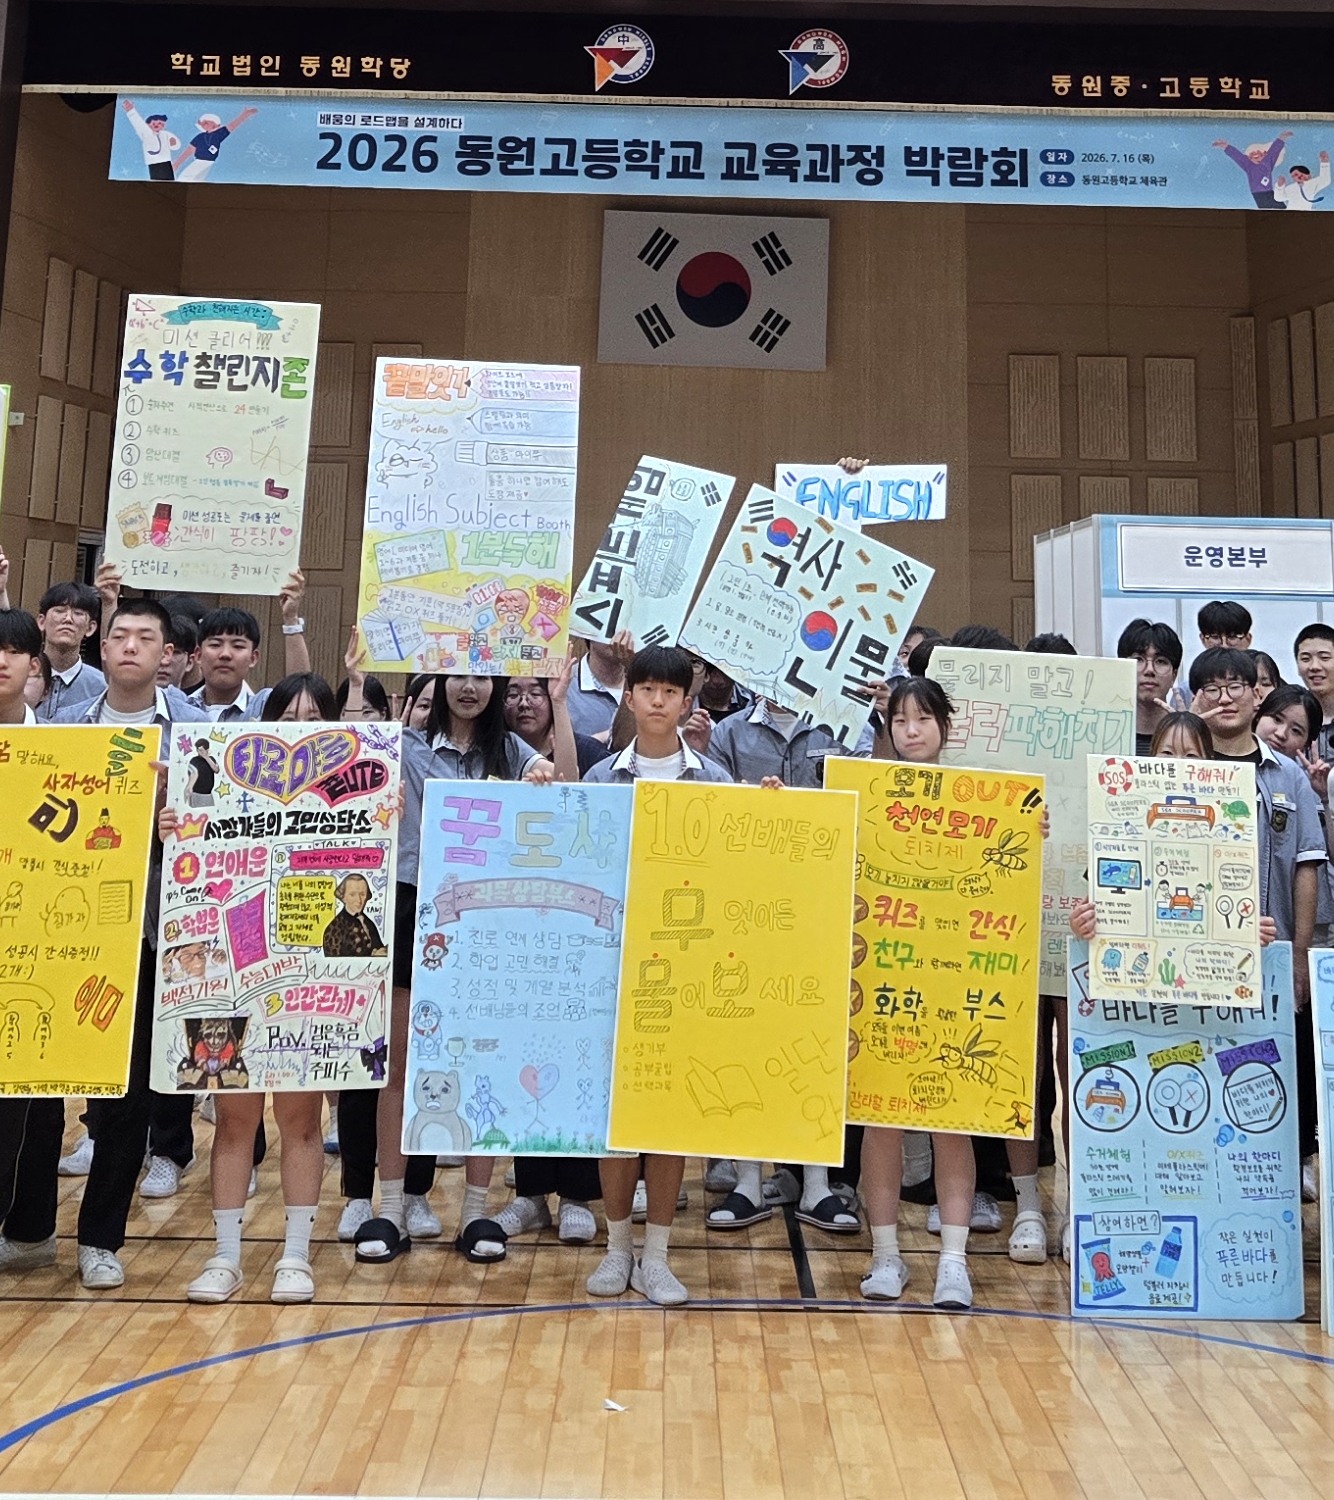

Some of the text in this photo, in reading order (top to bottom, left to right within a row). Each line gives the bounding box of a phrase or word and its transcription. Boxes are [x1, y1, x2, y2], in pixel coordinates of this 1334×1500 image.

[171, 53, 411, 80] 학교법인 동원학당
[319, 113, 463, 129] 배움의 로드맵을 설계하다
[316, 132, 705, 180] 2026 동원고등학교
[720, 141, 1030, 188] 교육과정 박람회
[1082, 175, 1167, 186] 동원고등학교 체육관
[163, 330, 199, 349] 미션
[124, 349, 189, 385] 수학
[383, 363, 470, 401] 끝말잇기
[367, 493, 570, 530] English Subject Booth
[796, 477, 932, 521] ENGLISH
[180, 527, 214, 542] 간식이
[462, 531, 560, 569] 1분독해
[1184, 545, 1268, 568] 운영본부
[132, 560, 178, 577] 도전하고,
[936, 660, 1011, 692] 물리지
[17, 749, 59, 770] 말해요,
[43, 772, 142, 795] 사자성어 퀴즈
[885, 768, 942, 800] 모기
[284, 810, 372, 836] 고민상담소
[440, 796, 502, 866] 꿈
[720, 813, 840, 862] 선배들의
[904, 835, 963, 861] 퇴치제
[205, 846, 267, 878] 연애운
[5, 944, 38, 961] 성공시
[468, 930, 561, 950] 진로 상담
[239, 954, 302, 990] 수능대박
[470, 952, 559, 970] 학업 고민 해결
[285, 985, 356, 1016] 인간관계
[468, 979, 586, 998] 성적 분석
[466, 1002, 560, 1021] 선배님들의 조언
[633, 1043, 667, 1057] 생기부
[1242, 1231, 1274, 1243] 실천이
[1242, 1250, 1278, 1266] 바다를
